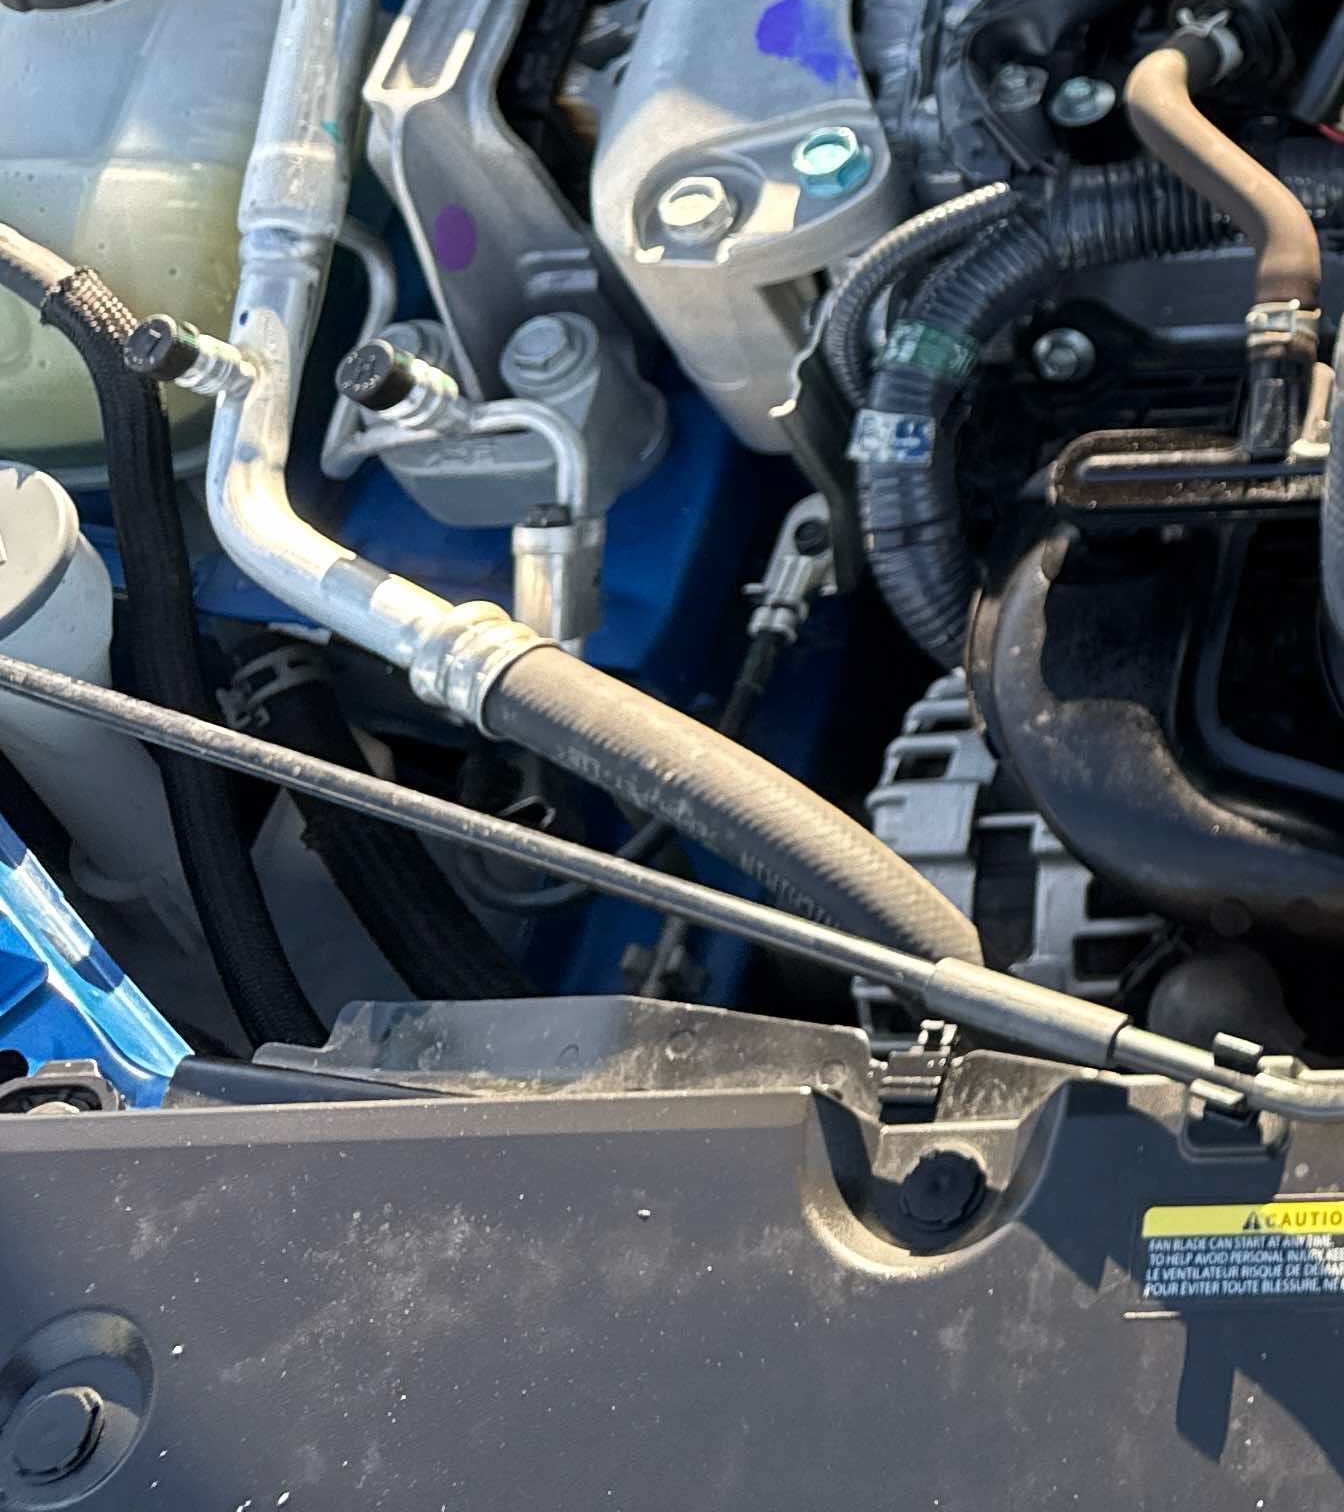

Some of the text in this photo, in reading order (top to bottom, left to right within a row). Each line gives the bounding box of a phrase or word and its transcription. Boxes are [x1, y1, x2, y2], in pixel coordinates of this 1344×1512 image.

[1209, 1237, 1232, 1250] CAN
[1149, 1253, 1164, 1266] TO
[1165, 1252, 1193, 1266] HELP
[1194, 1251, 1229, 1265] AVOID
[1230, 1250, 1284, 1264] PERSONAL
